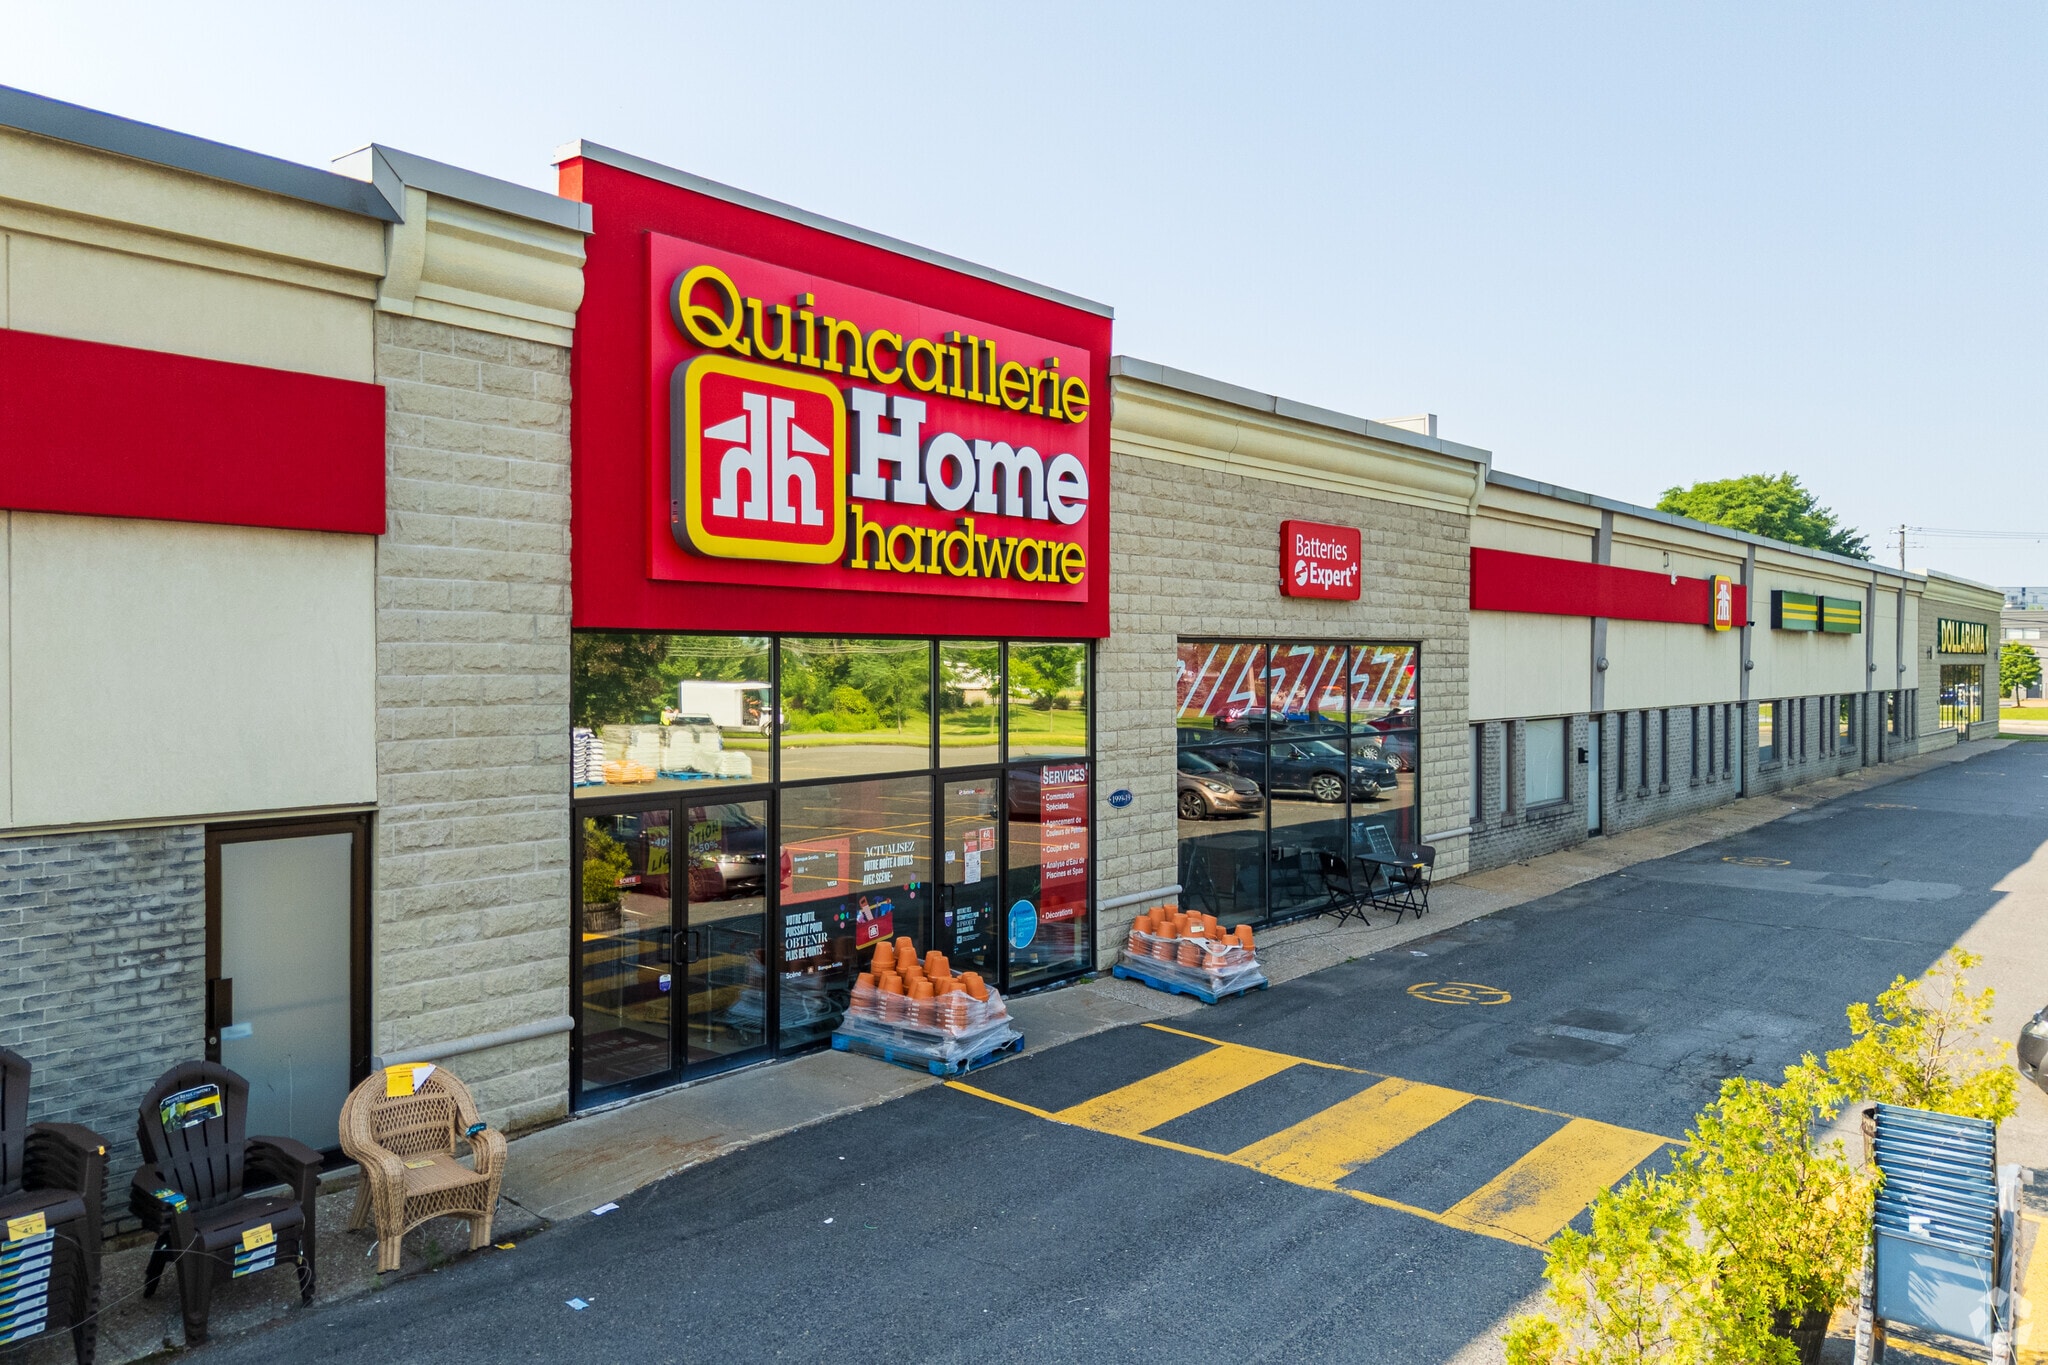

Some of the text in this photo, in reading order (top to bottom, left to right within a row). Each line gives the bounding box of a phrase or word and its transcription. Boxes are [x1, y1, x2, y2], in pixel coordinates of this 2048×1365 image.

[673, 265, 1090, 425] Quincaillerie
[848, 386, 1089, 526] Home
[848, 503, 1087, 586] hardware
[1296, 534, 1348, 561] Batteries
[1941, 620, 1985, 653] DOLLARAMA
[1043, 768, 1085, 785] SERVICES
[1045, 791, 1075, 801] Commandes
[864, 841, 915, 858] ACTUALISEZ
[862, 873, 875, 886] AVEC
[1046, 870, 1066, 879] Piscines
[785, 923, 809, 938] PUISSANT
[785, 932, 828, 949] OBTENIR
[785, 949, 798, 962] PLUS
[798, 948, 805, 959] DE
